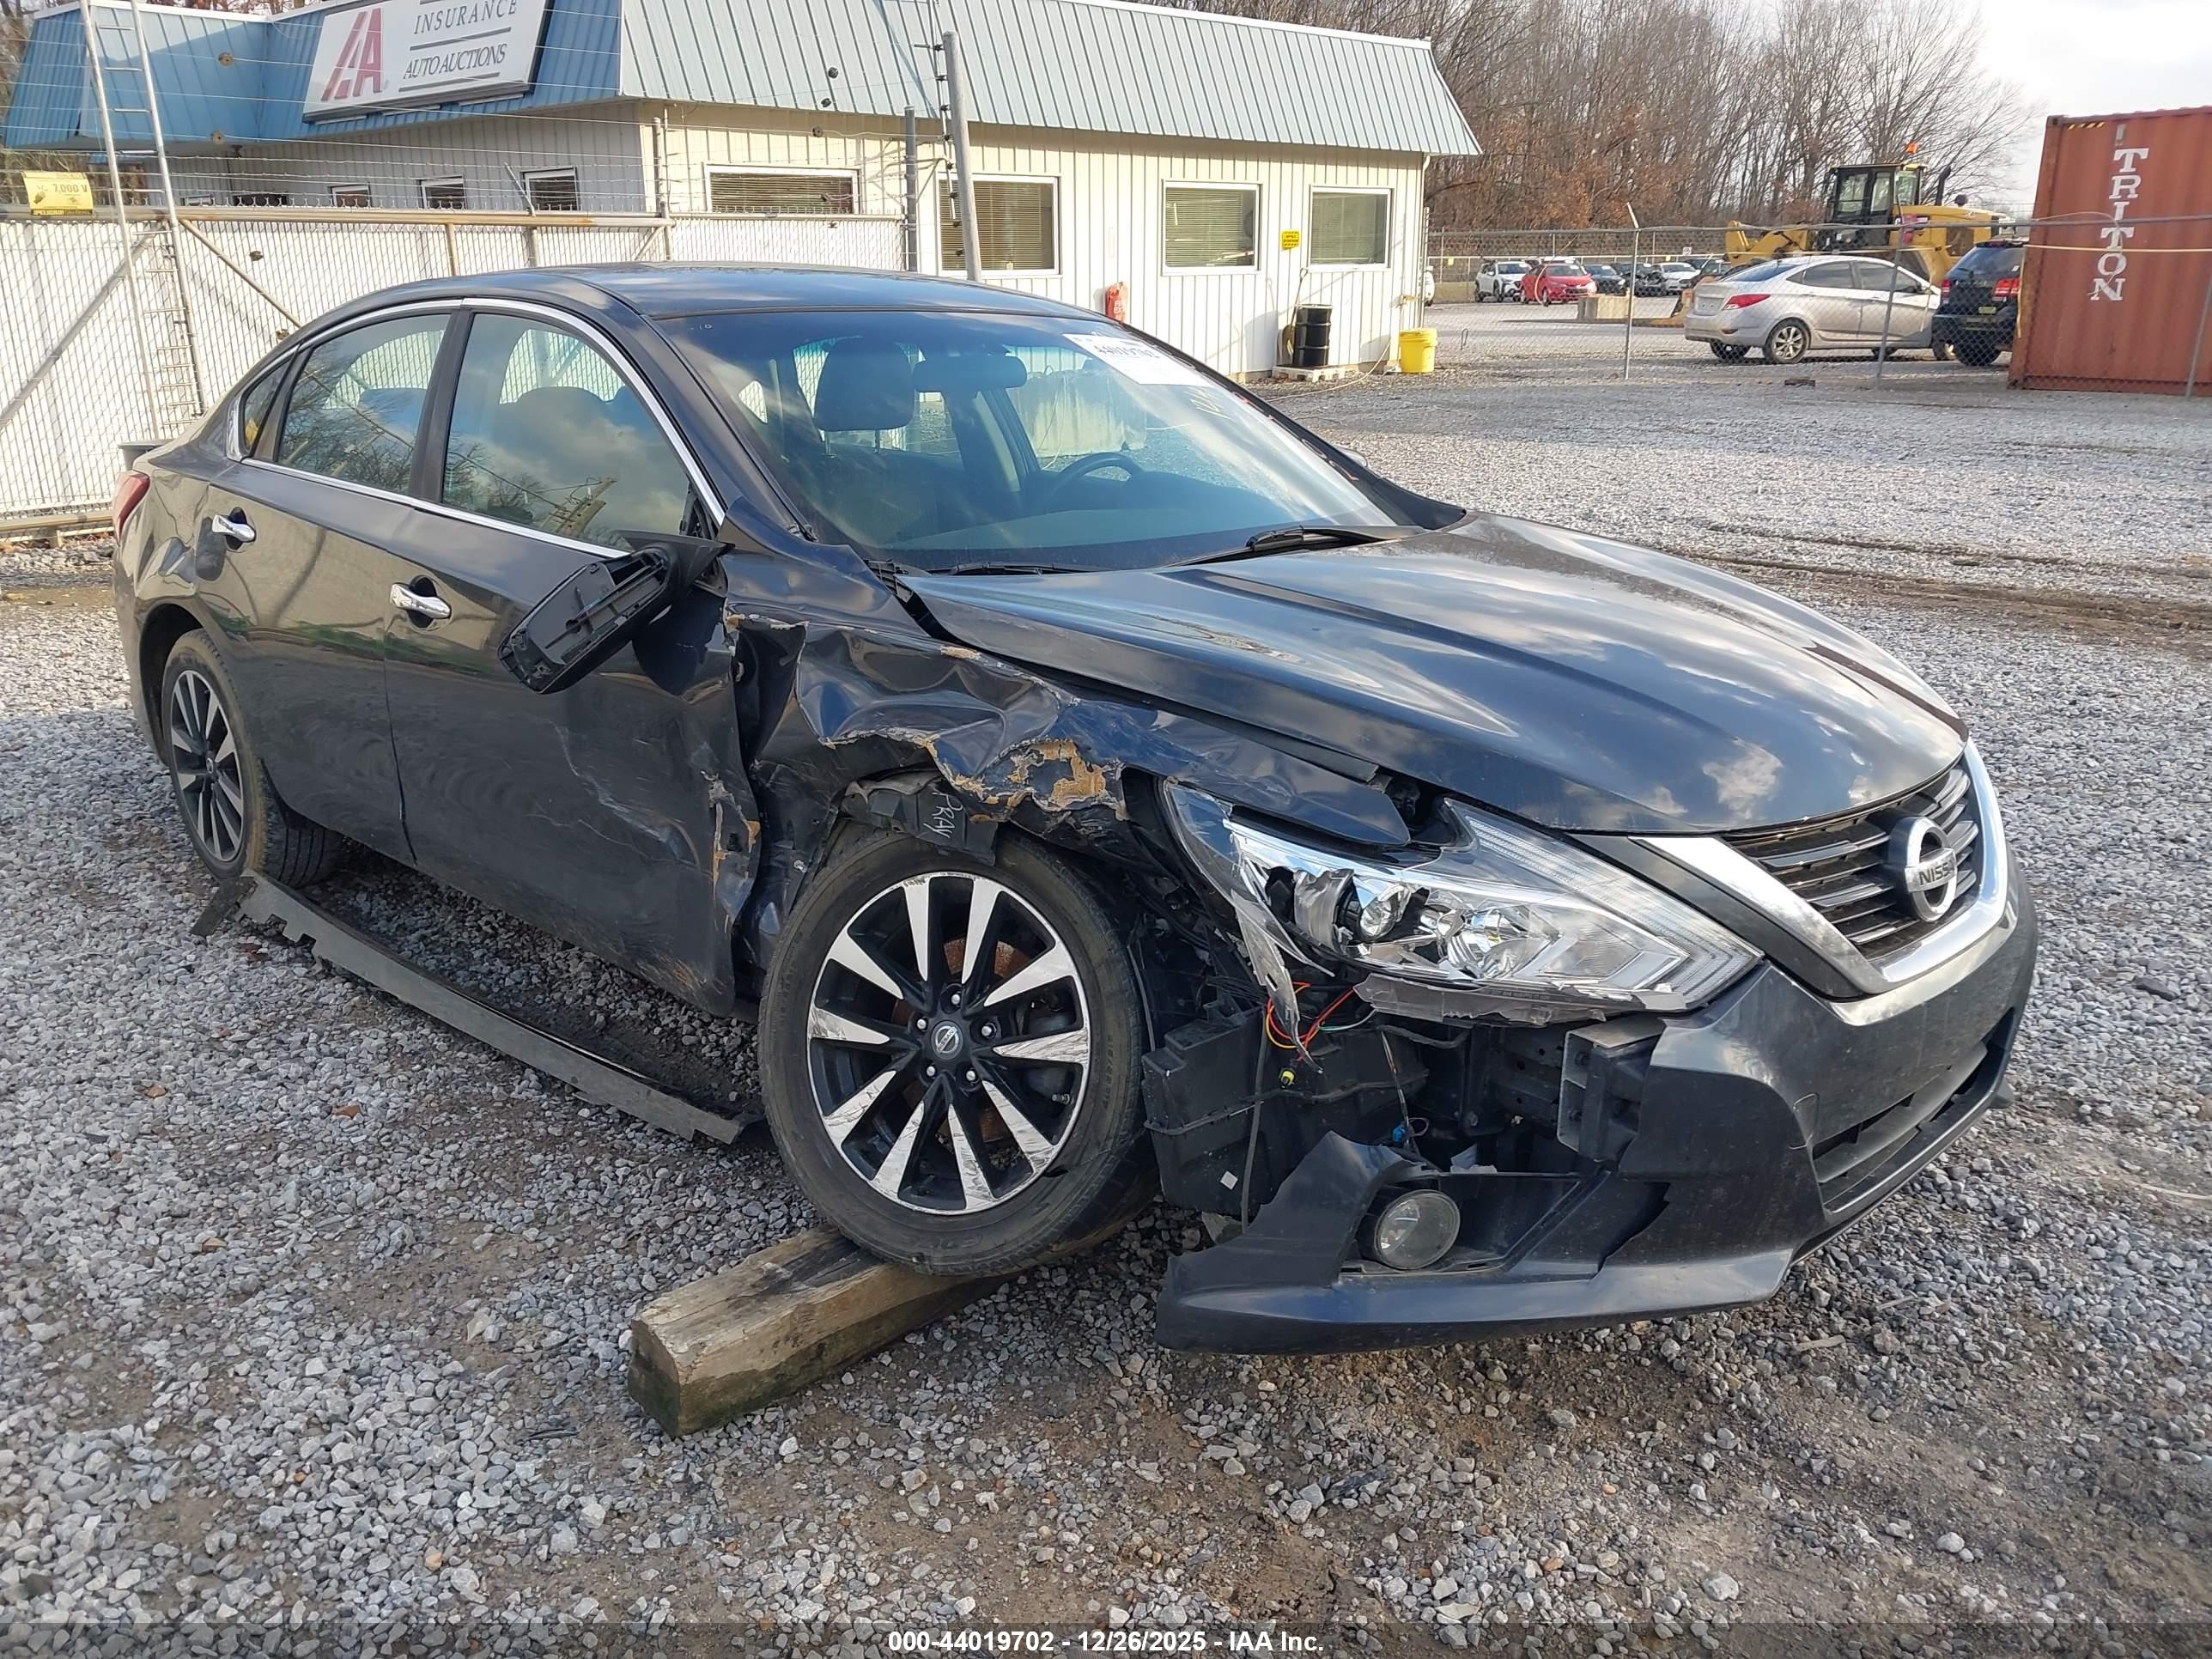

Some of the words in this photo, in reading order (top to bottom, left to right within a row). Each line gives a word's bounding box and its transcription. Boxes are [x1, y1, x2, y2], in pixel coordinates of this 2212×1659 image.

[414, 0, 517, 34] INSURANCE
[403, 56, 441, 80] AUTO
[439, 44, 507, 74] AUCTIONS
[52, 183, 79, 194] 7,000
[82, 183, 88, 193] V
[2089, 147, 2150, 301] TRITON
